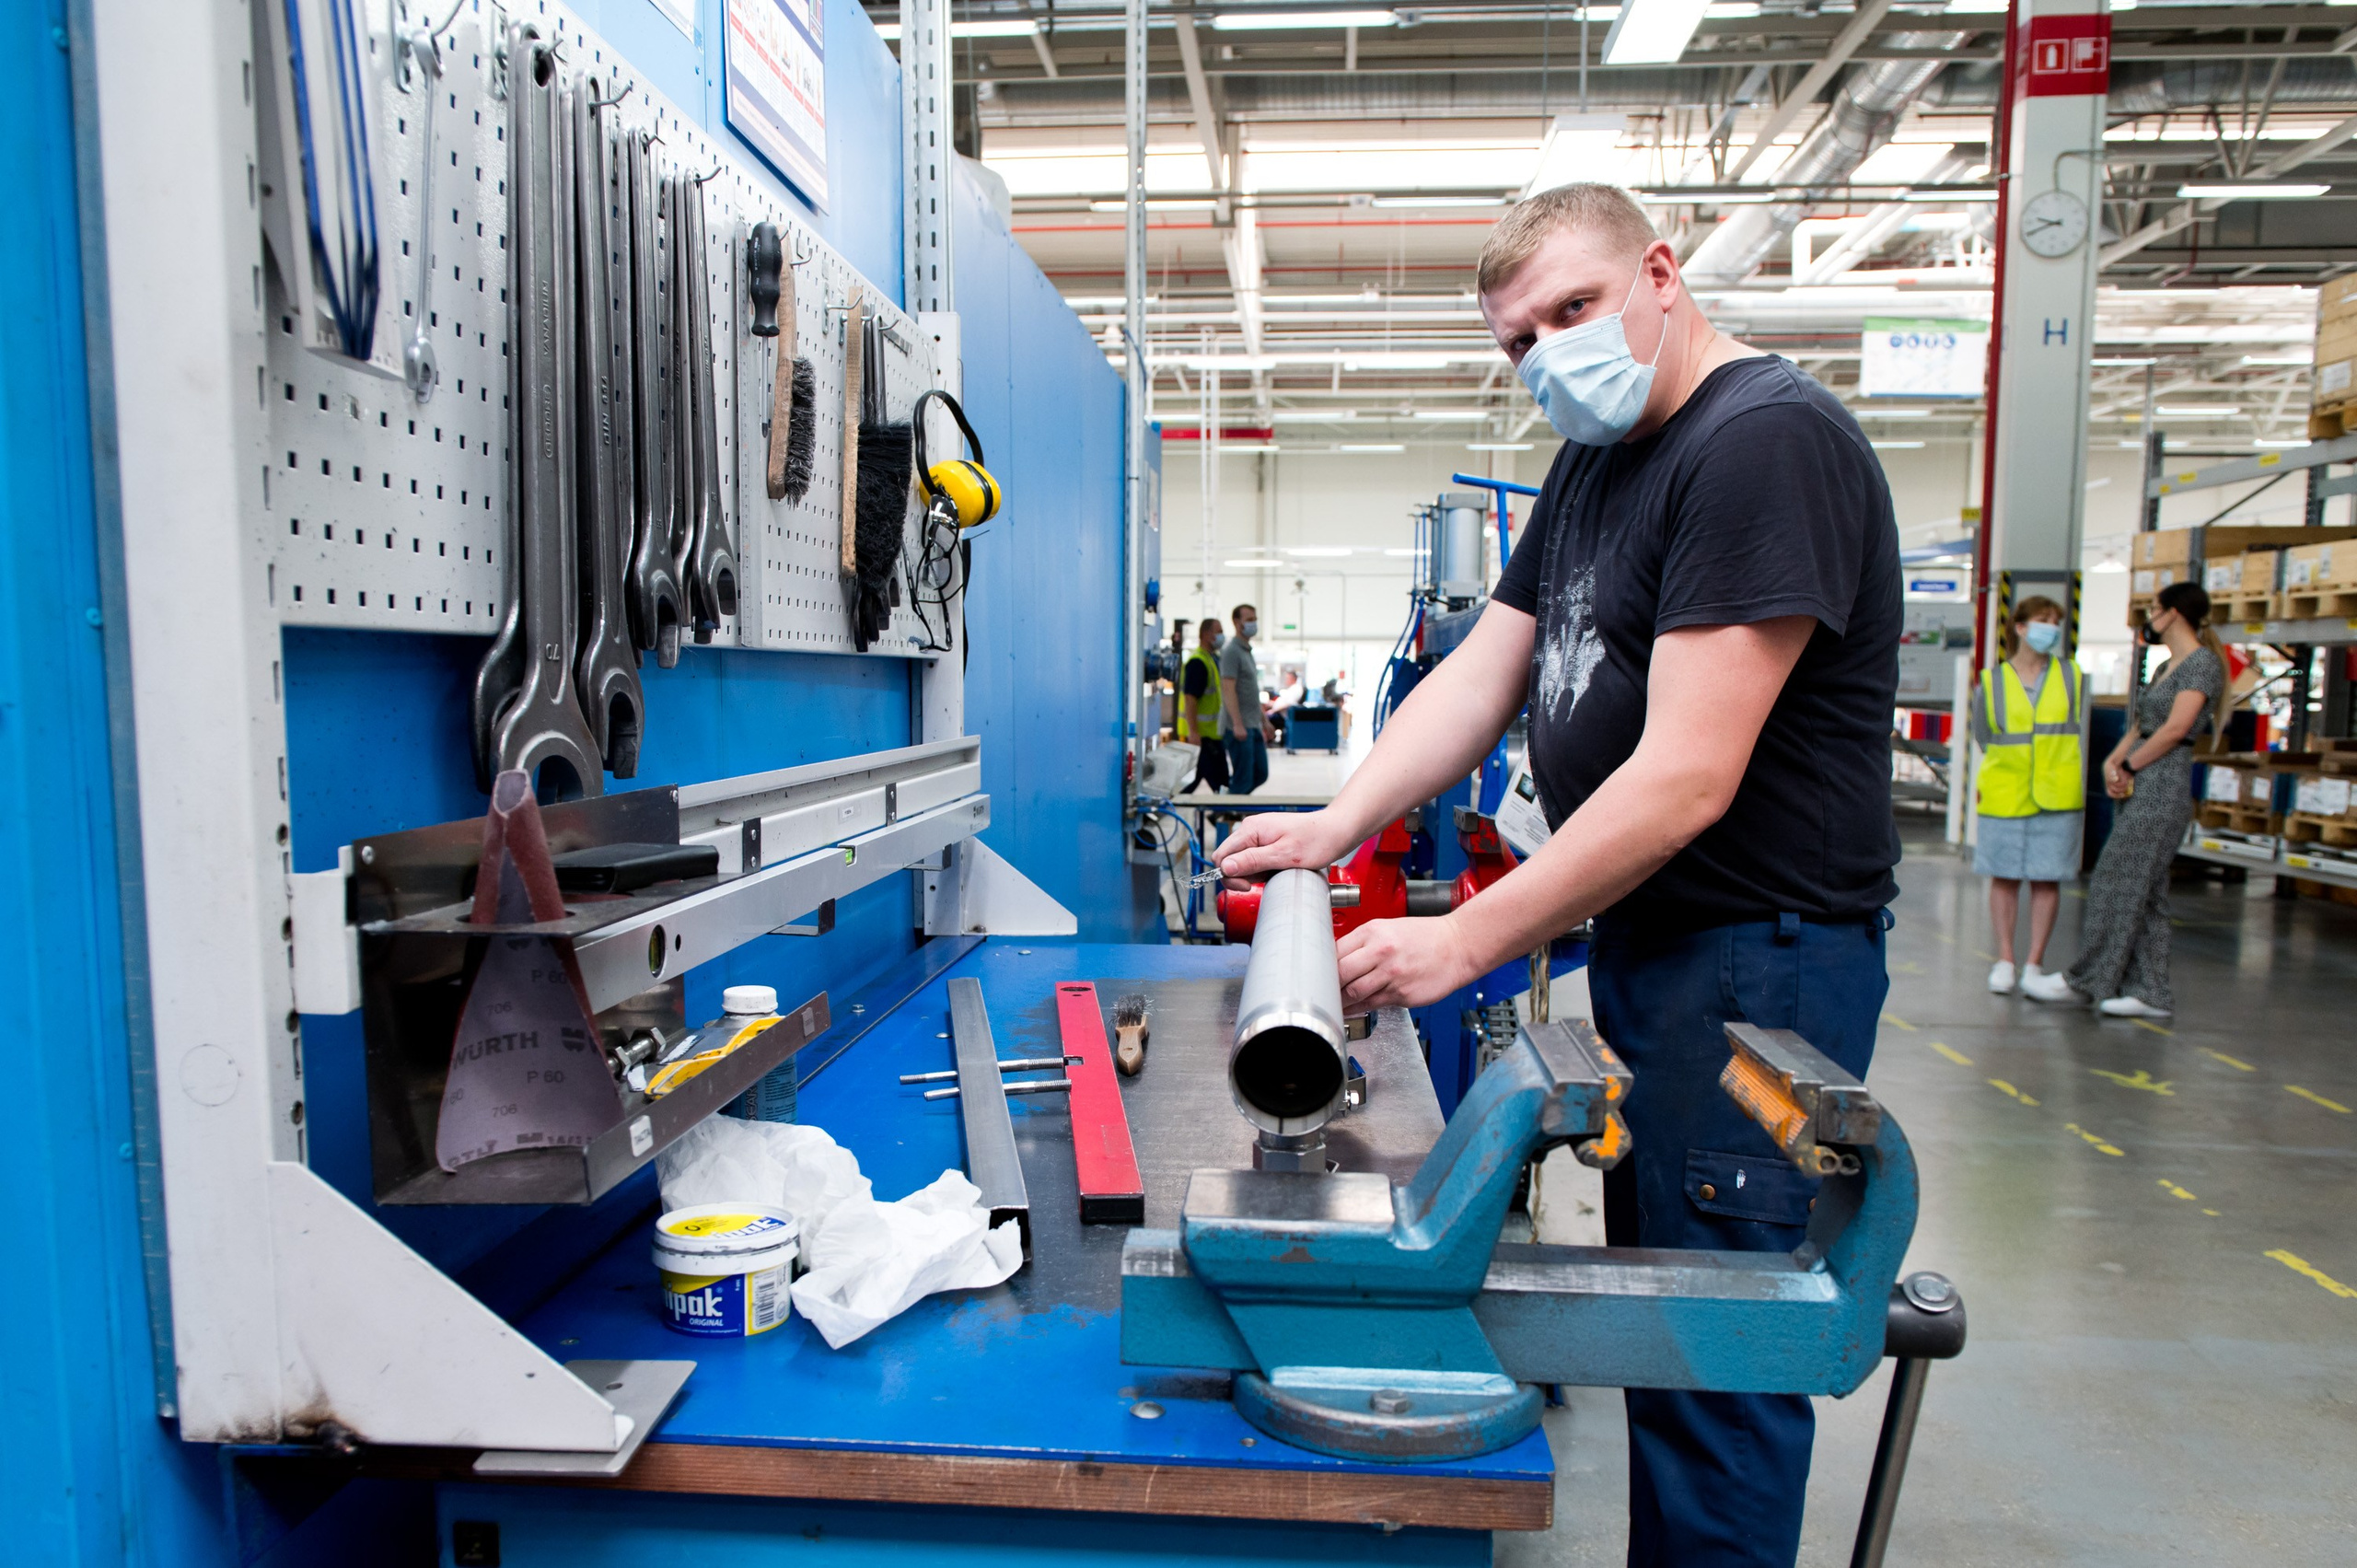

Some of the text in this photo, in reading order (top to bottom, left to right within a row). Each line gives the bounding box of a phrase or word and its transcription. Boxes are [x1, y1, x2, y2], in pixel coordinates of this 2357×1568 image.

[2043, 317, 2069, 346] H
[453, 1030, 540, 1070] WÜRTH
[492, 1103, 518, 1118] 706
[689, 1318, 724, 1327] ORIGINAL
